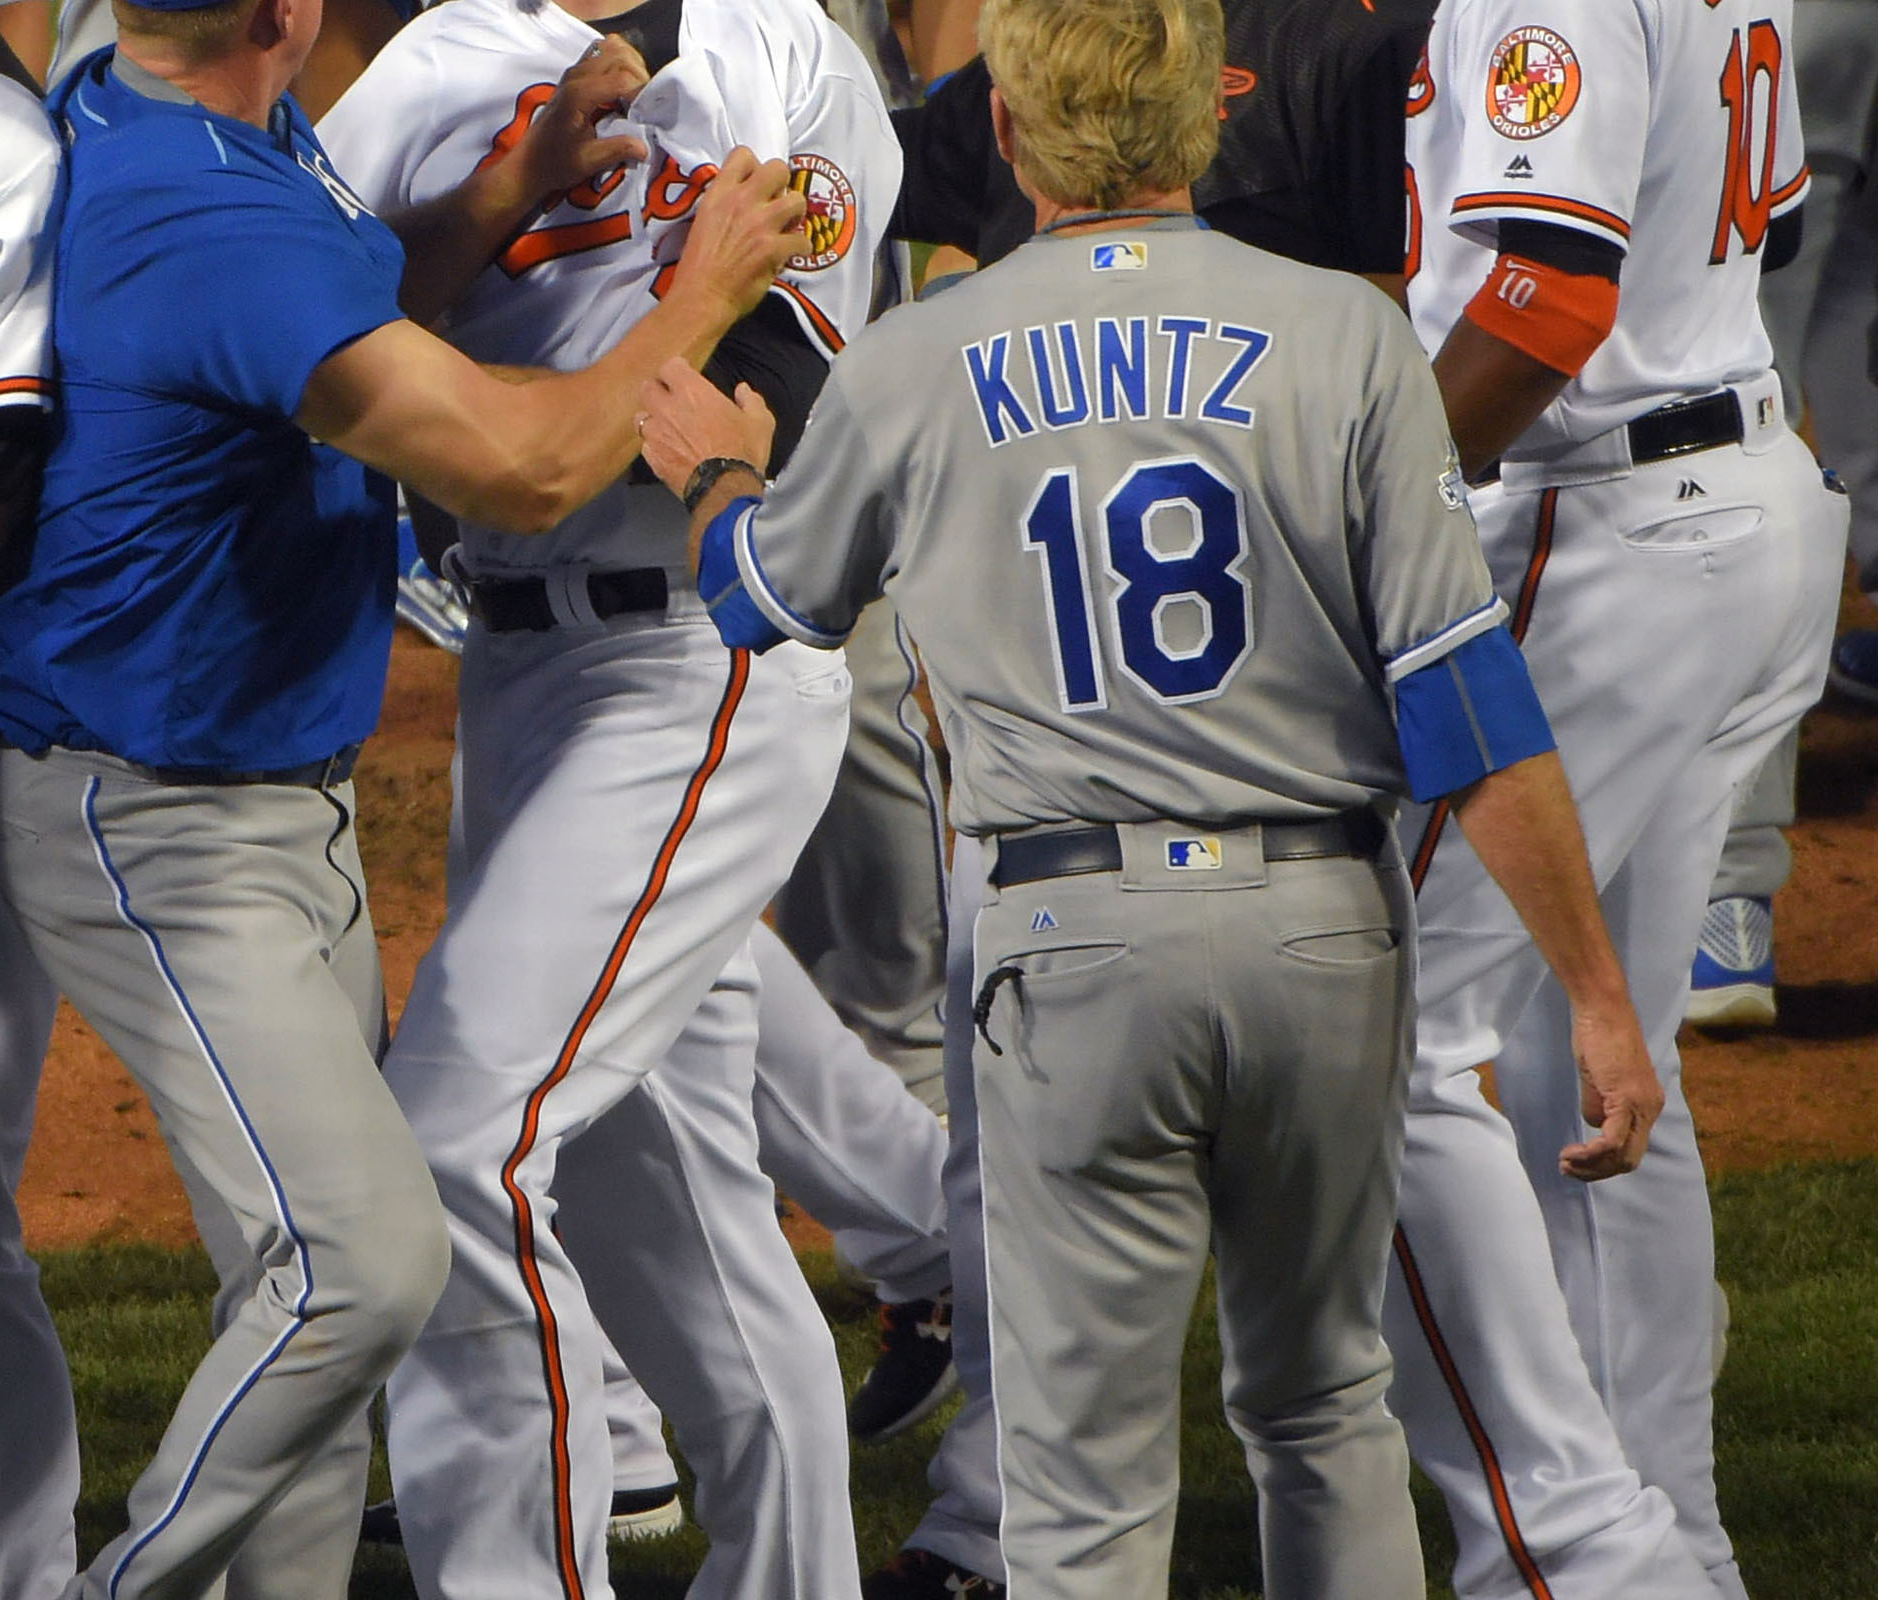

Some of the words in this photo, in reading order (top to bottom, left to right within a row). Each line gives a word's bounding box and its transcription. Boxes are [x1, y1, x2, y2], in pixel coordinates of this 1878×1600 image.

[1492, 28, 1575, 68] BALTIMORE
[1492, 111, 1562, 137] ORIOLES
[1707, 18, 1783, 267] 10
[789, 156, 855, 206] LTIMORE
[791, 250, 839, 268] OLES
[1497, 270, 1539, 309] 10
[961, 314, 1274, 450] KUNTZ
[1020, 453, 1256, 714] 18
